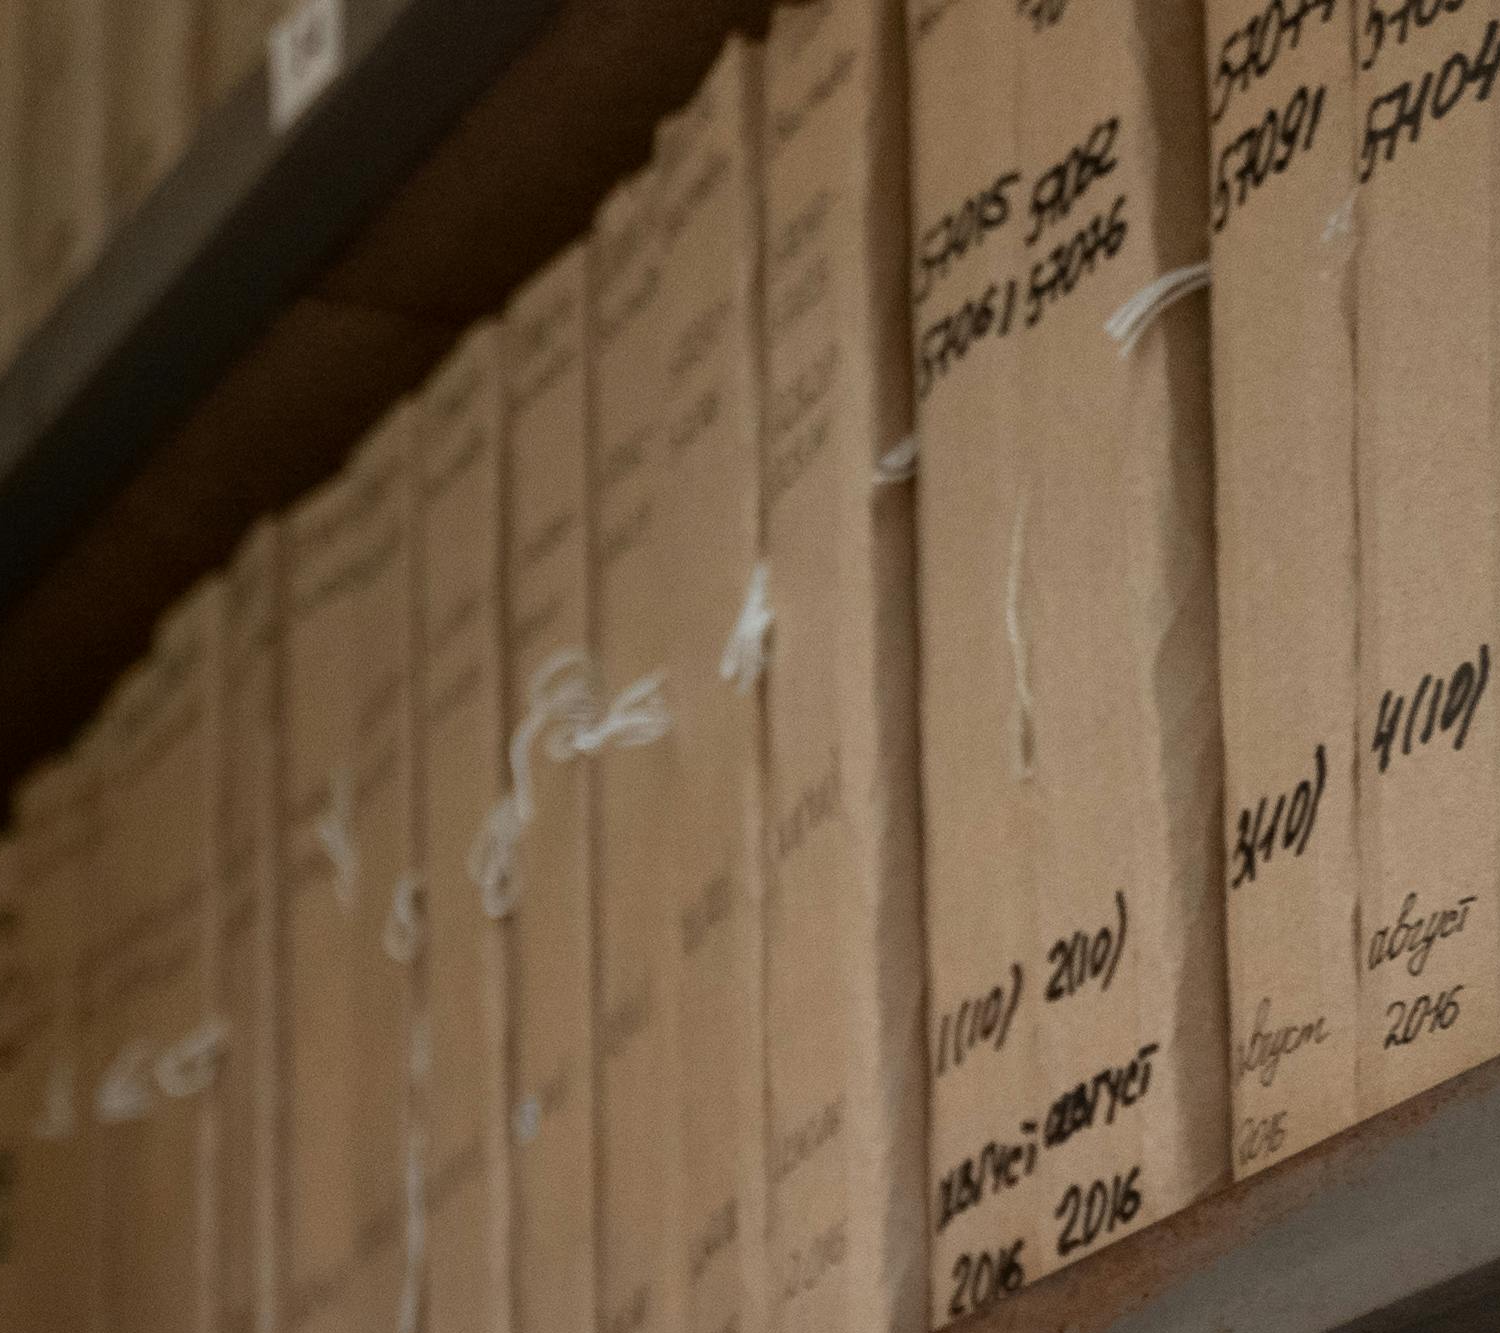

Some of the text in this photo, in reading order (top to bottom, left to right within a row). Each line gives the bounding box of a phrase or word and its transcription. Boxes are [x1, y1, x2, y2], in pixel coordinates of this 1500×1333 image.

[1370, 644, 1489, 774] 4(10)
[1384, 984, 1464, 1050] 2016
[1055, 1167, 1140, 1256] 2016
